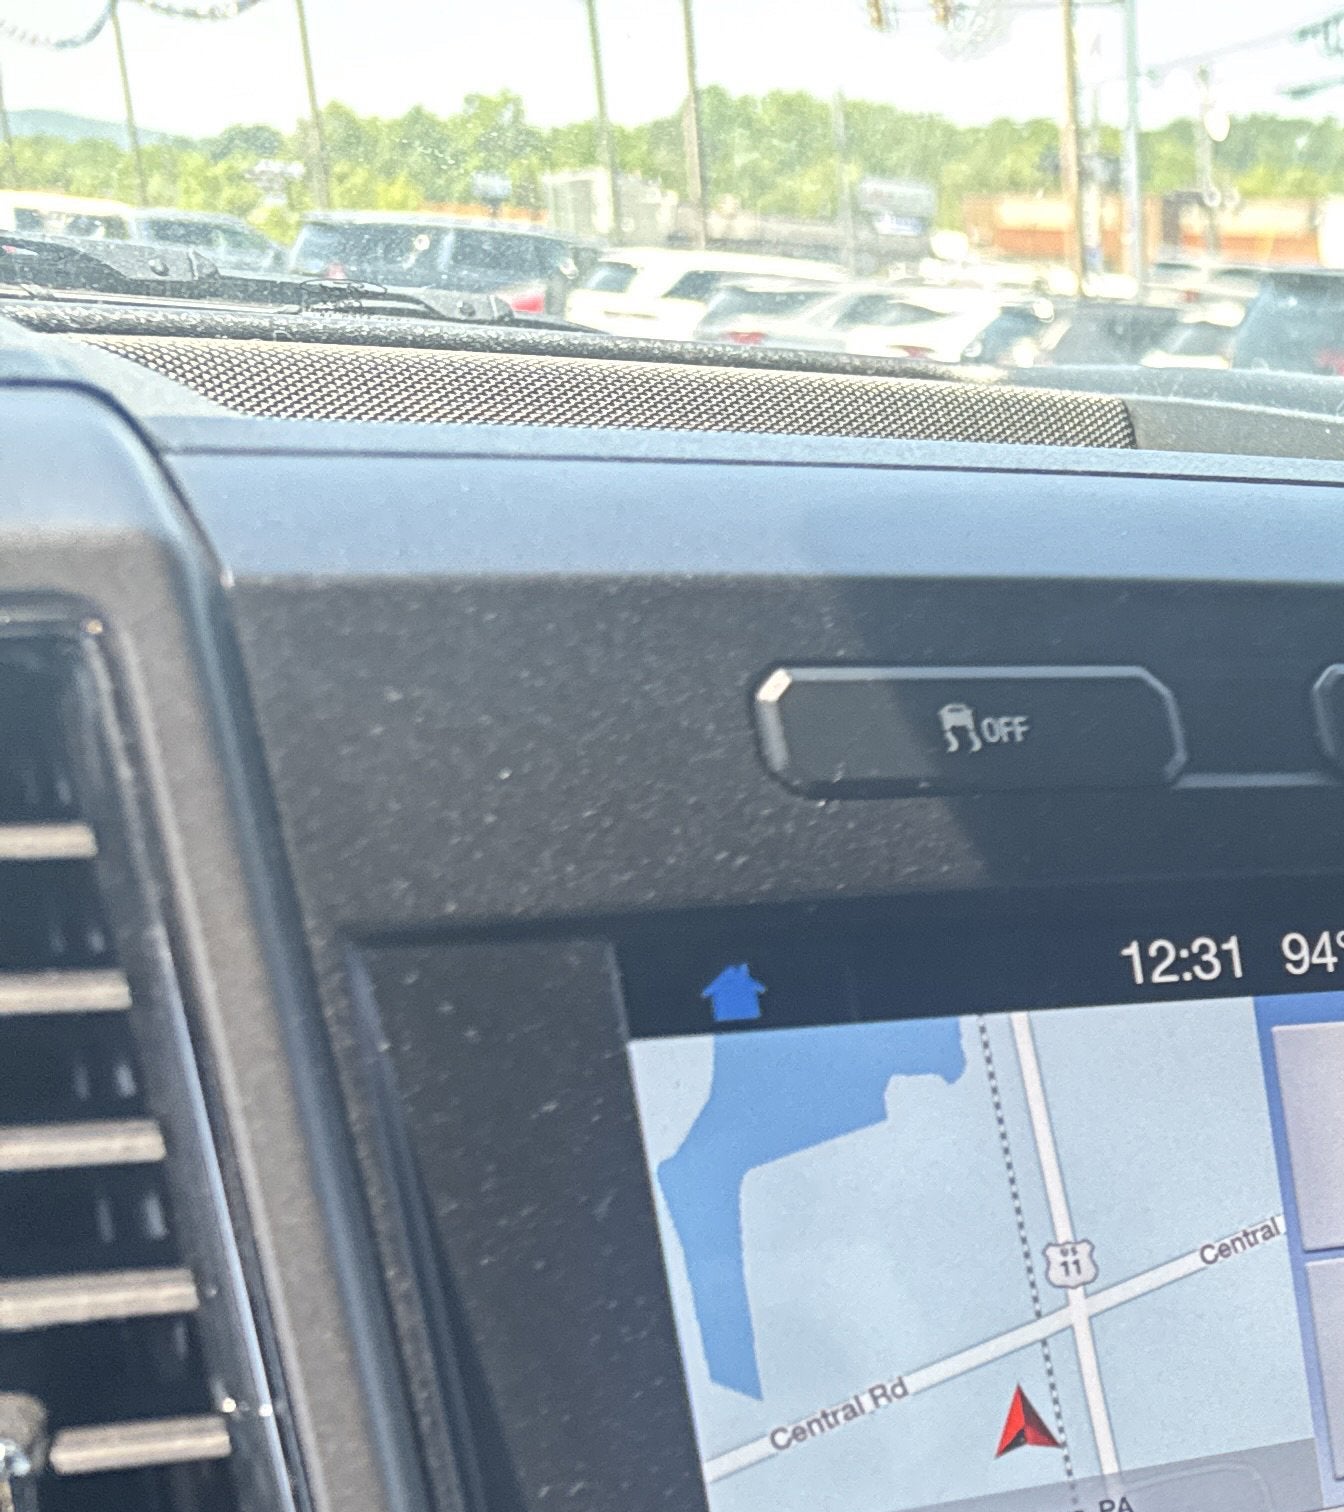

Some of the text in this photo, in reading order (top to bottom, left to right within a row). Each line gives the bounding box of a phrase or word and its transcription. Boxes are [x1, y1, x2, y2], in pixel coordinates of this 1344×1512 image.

[981, 715, 1029, 743] OFF
[1121, 935, 1243, 985] 12:31
[1199, 1216, 1282, 1265] Central
[1060, 1259, 1082, 1277] 11
[770, 1375, 909, 1451] Central Rd
